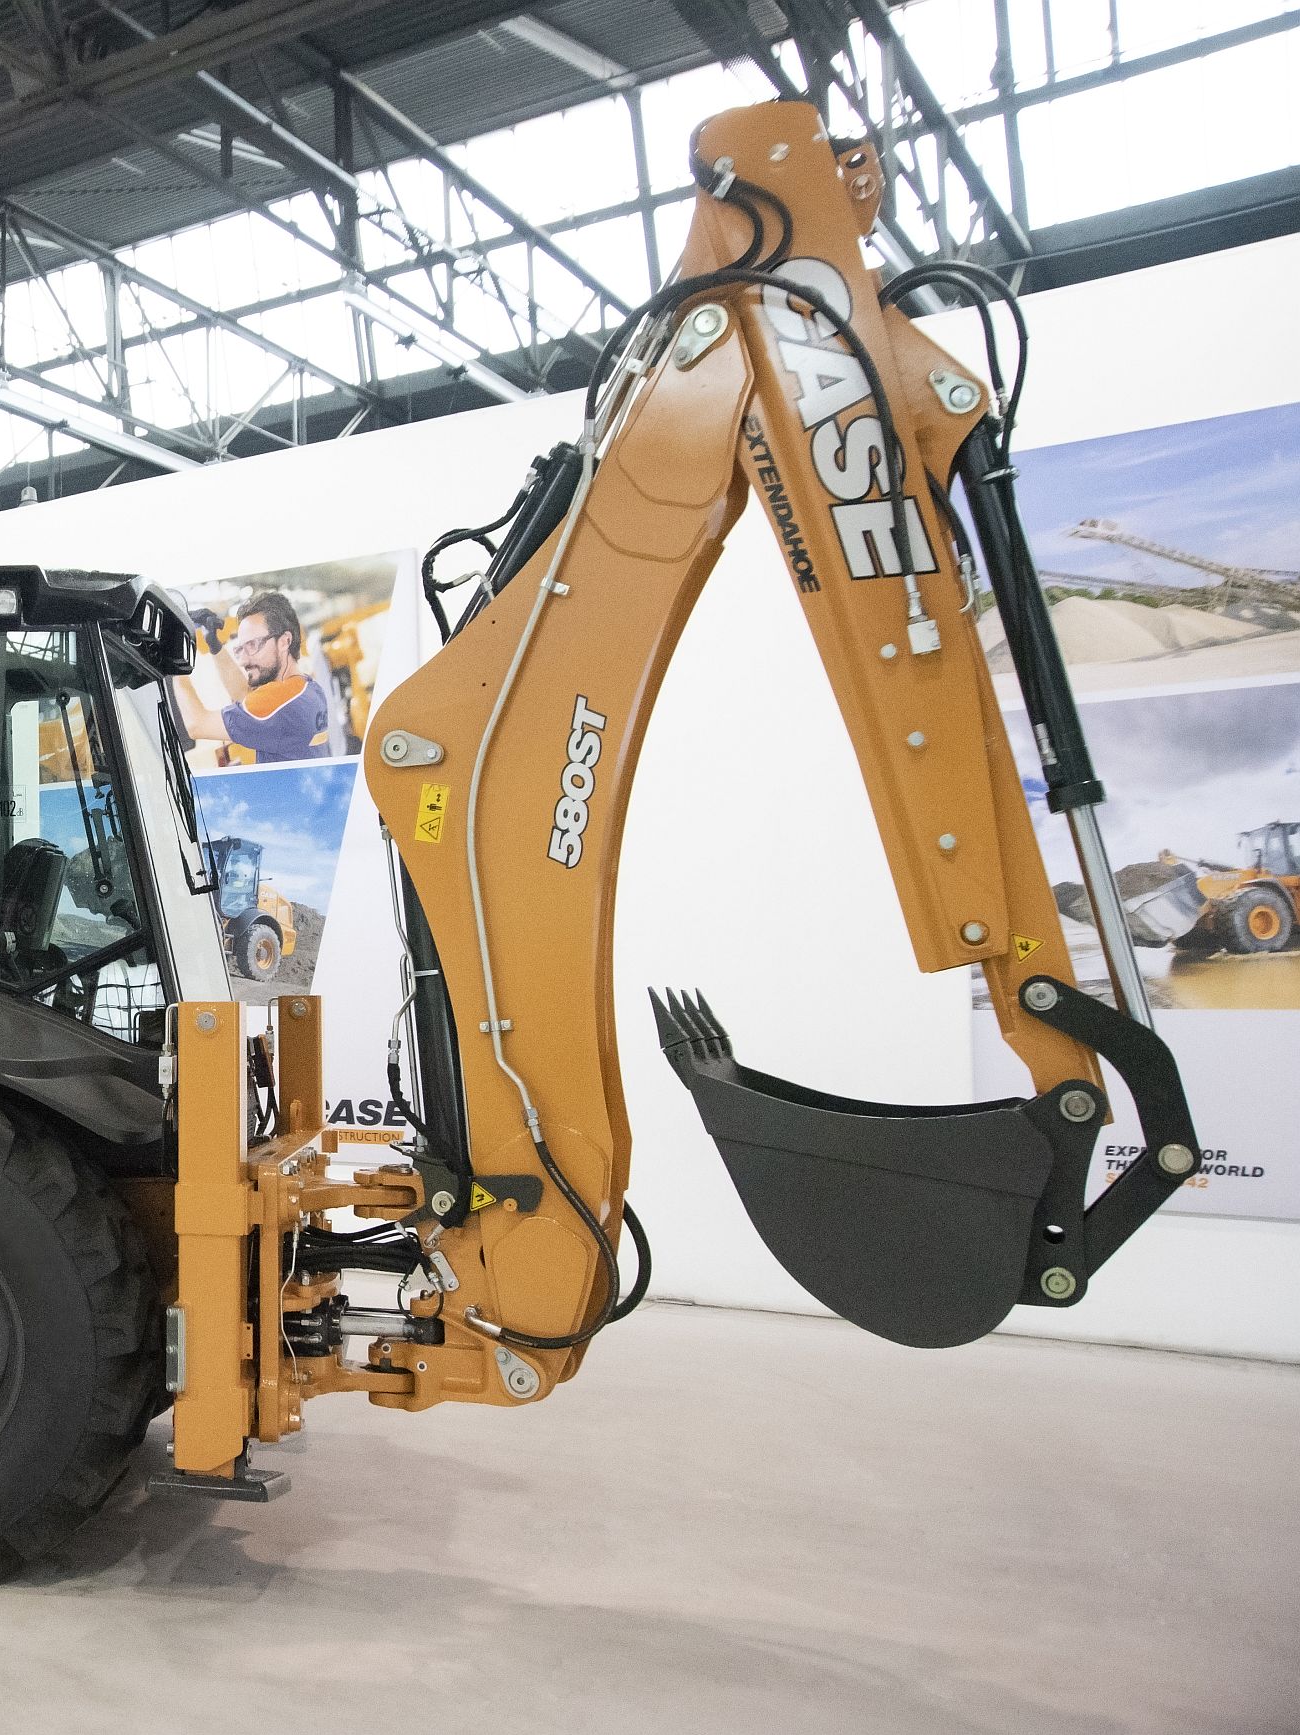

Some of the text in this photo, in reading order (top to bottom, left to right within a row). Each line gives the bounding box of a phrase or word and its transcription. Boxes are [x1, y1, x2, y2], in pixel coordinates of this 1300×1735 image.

[762, 257, 940, 580] CASE
[743, 414, 821, 594] EXTENDAHOE
[0, 800, 17, 817] 102
[547, 693, 607, 869] 580ST
[339, 1131, 400, 1142] STRUCTION
[1105, 1145, 1227, 1161] EXP OR
